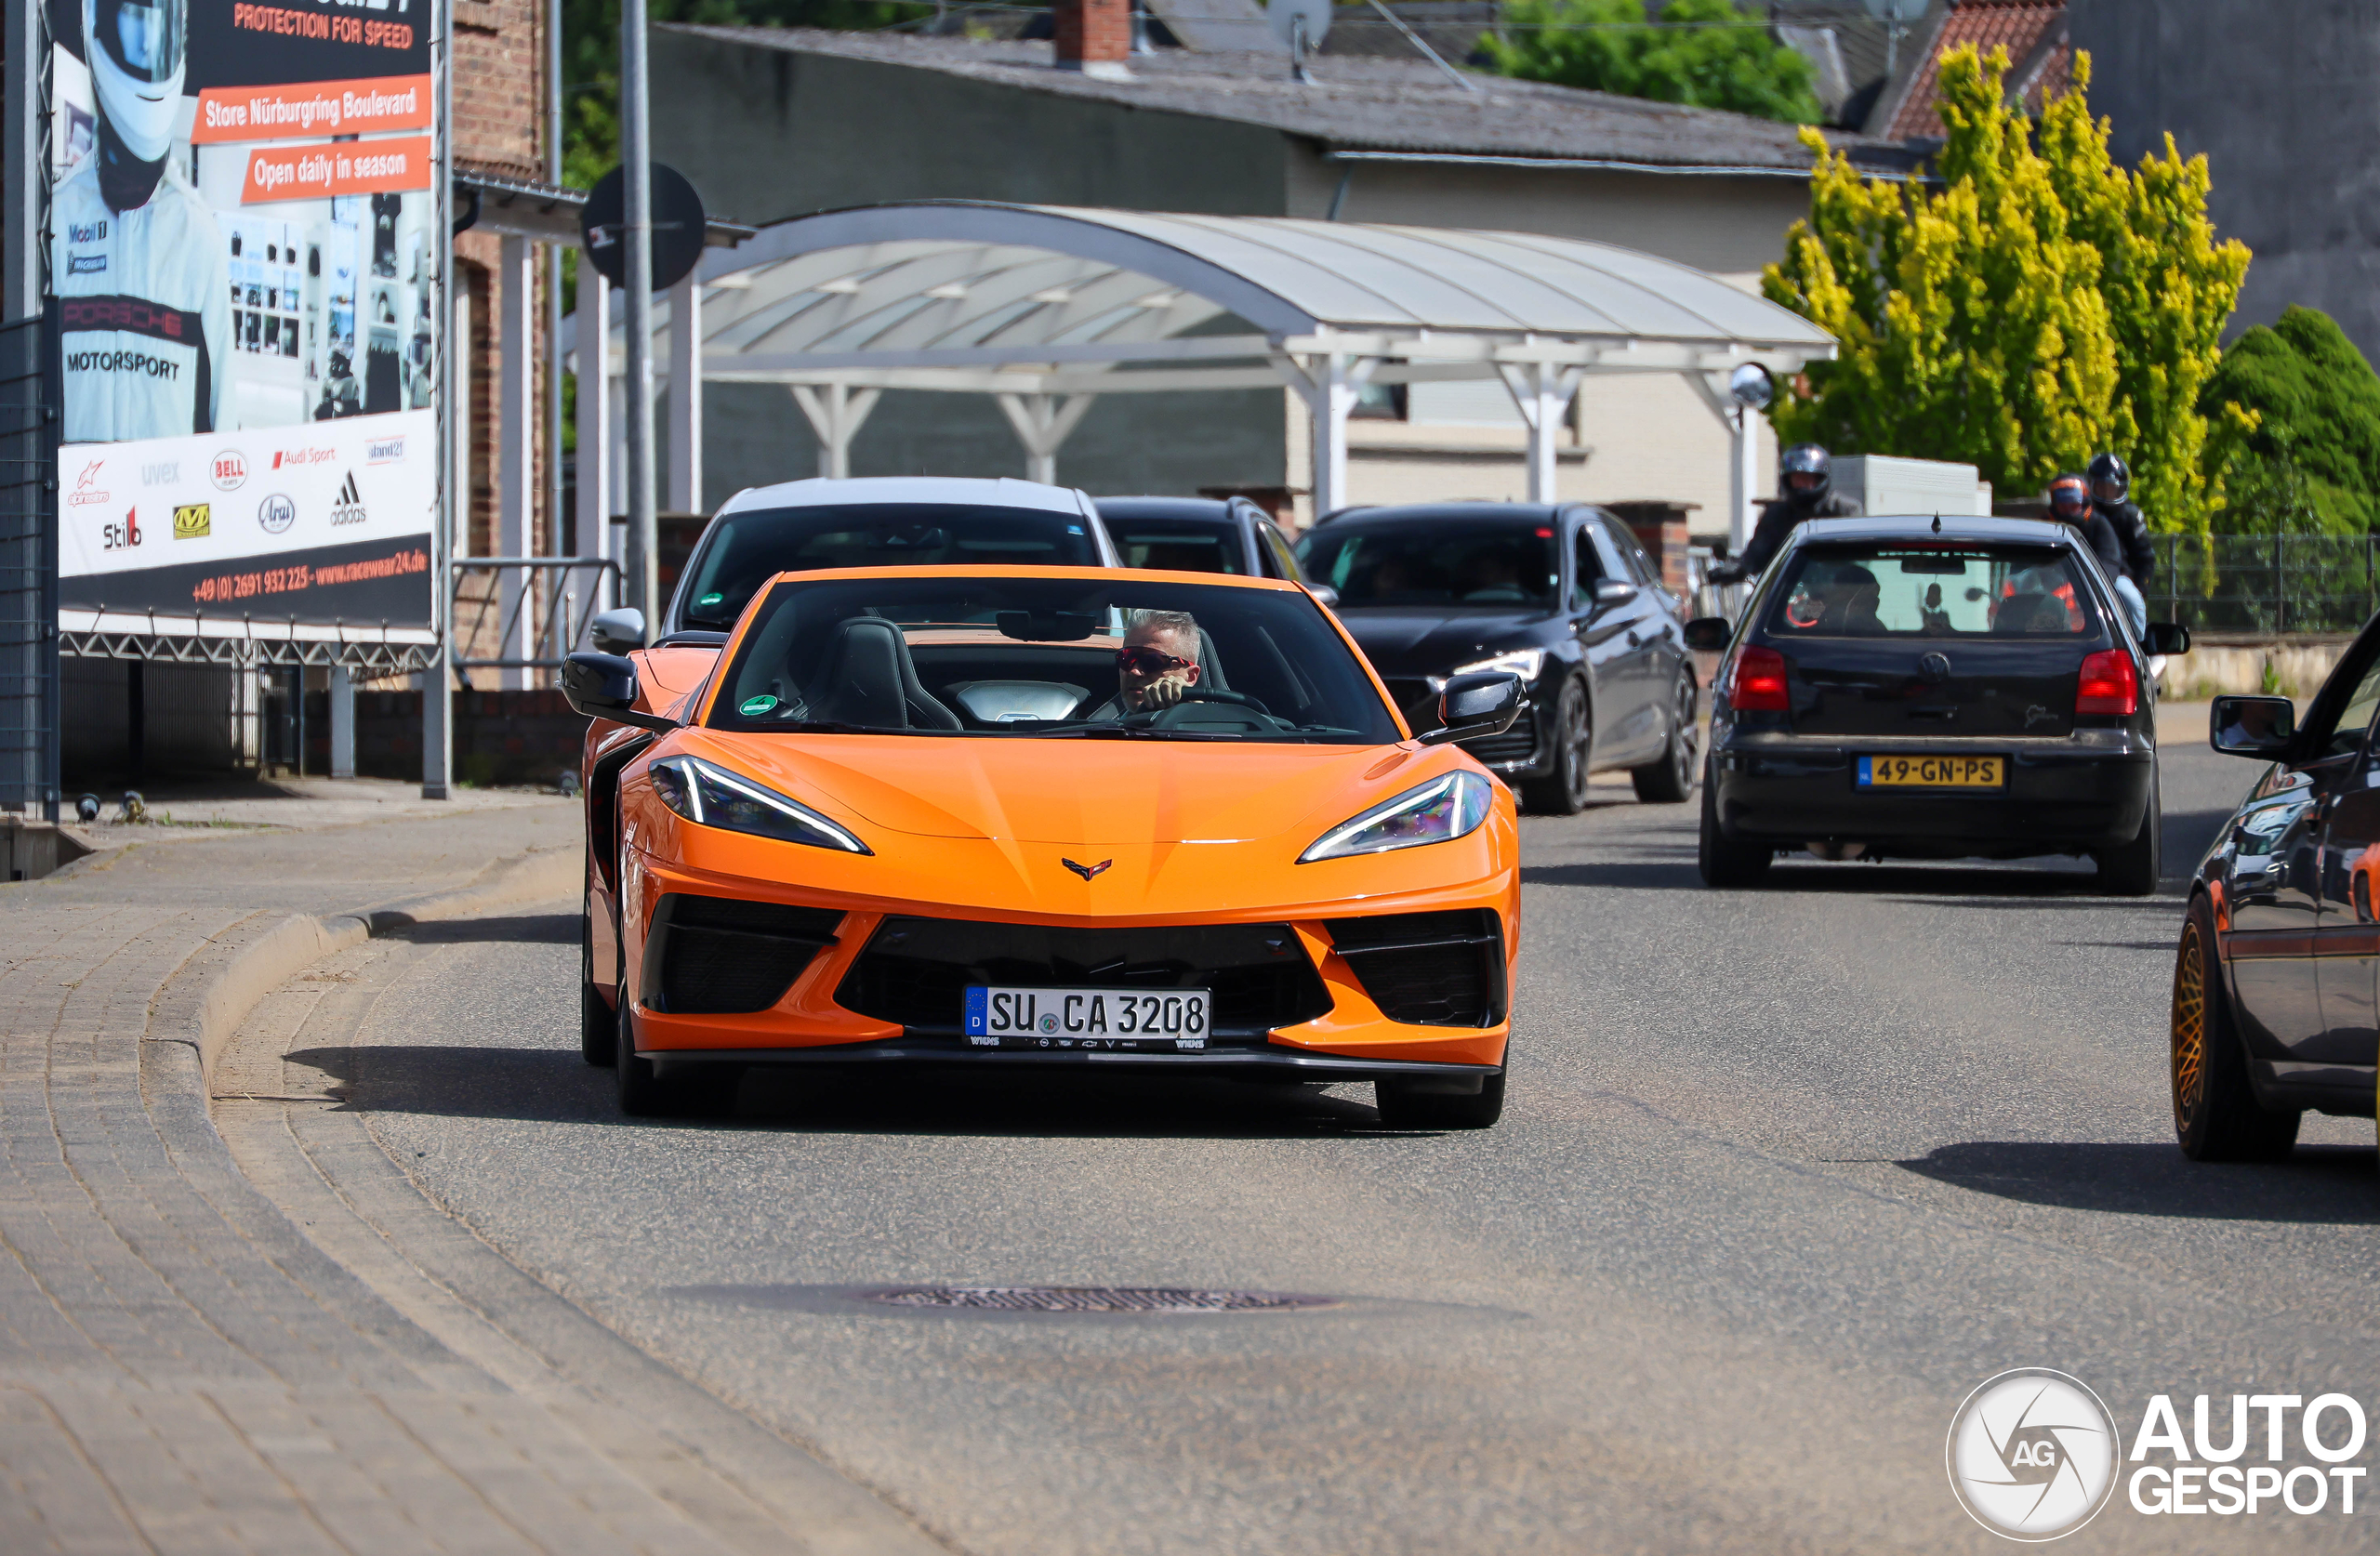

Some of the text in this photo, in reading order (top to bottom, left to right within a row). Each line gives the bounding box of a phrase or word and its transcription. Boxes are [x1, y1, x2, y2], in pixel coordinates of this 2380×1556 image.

[234, 3, 414, 49] PROTECTION FOR SPEED
[205, 86, 416, 128] Store Nürburgring Boulevard
[254, 152, 405, 191] Open daily in season
[69, 223, 96, 244] Mobil
[63, 301, 182, 336] PORSCHE
[67, 350, 179, 381] MOTORSPORT
[216, 459, 244, 479] BELL
[284, 446, 336, 466] Audi Sport
[141, 461, 180, 486] uvex
[261, 499, 290, 523] Arai
[330, 505, 366, 527] adidas
[103, 505, 142, 550] Stilo
[192, 578, 216, 602] +49
[217, 574, 232, 602] (0)
[233, 571, 262, 598] 2691
[264, 568, 284, 594] 932
[286, 564, 310, 590] 225
[315, 547, 428, 587] www.racewear24.de
[1877, 758, 1994, 782] 49-GN-PS
[972, 1016, 980, 1027] D
[991, 993, 1204, 1034] SU CA 3208
